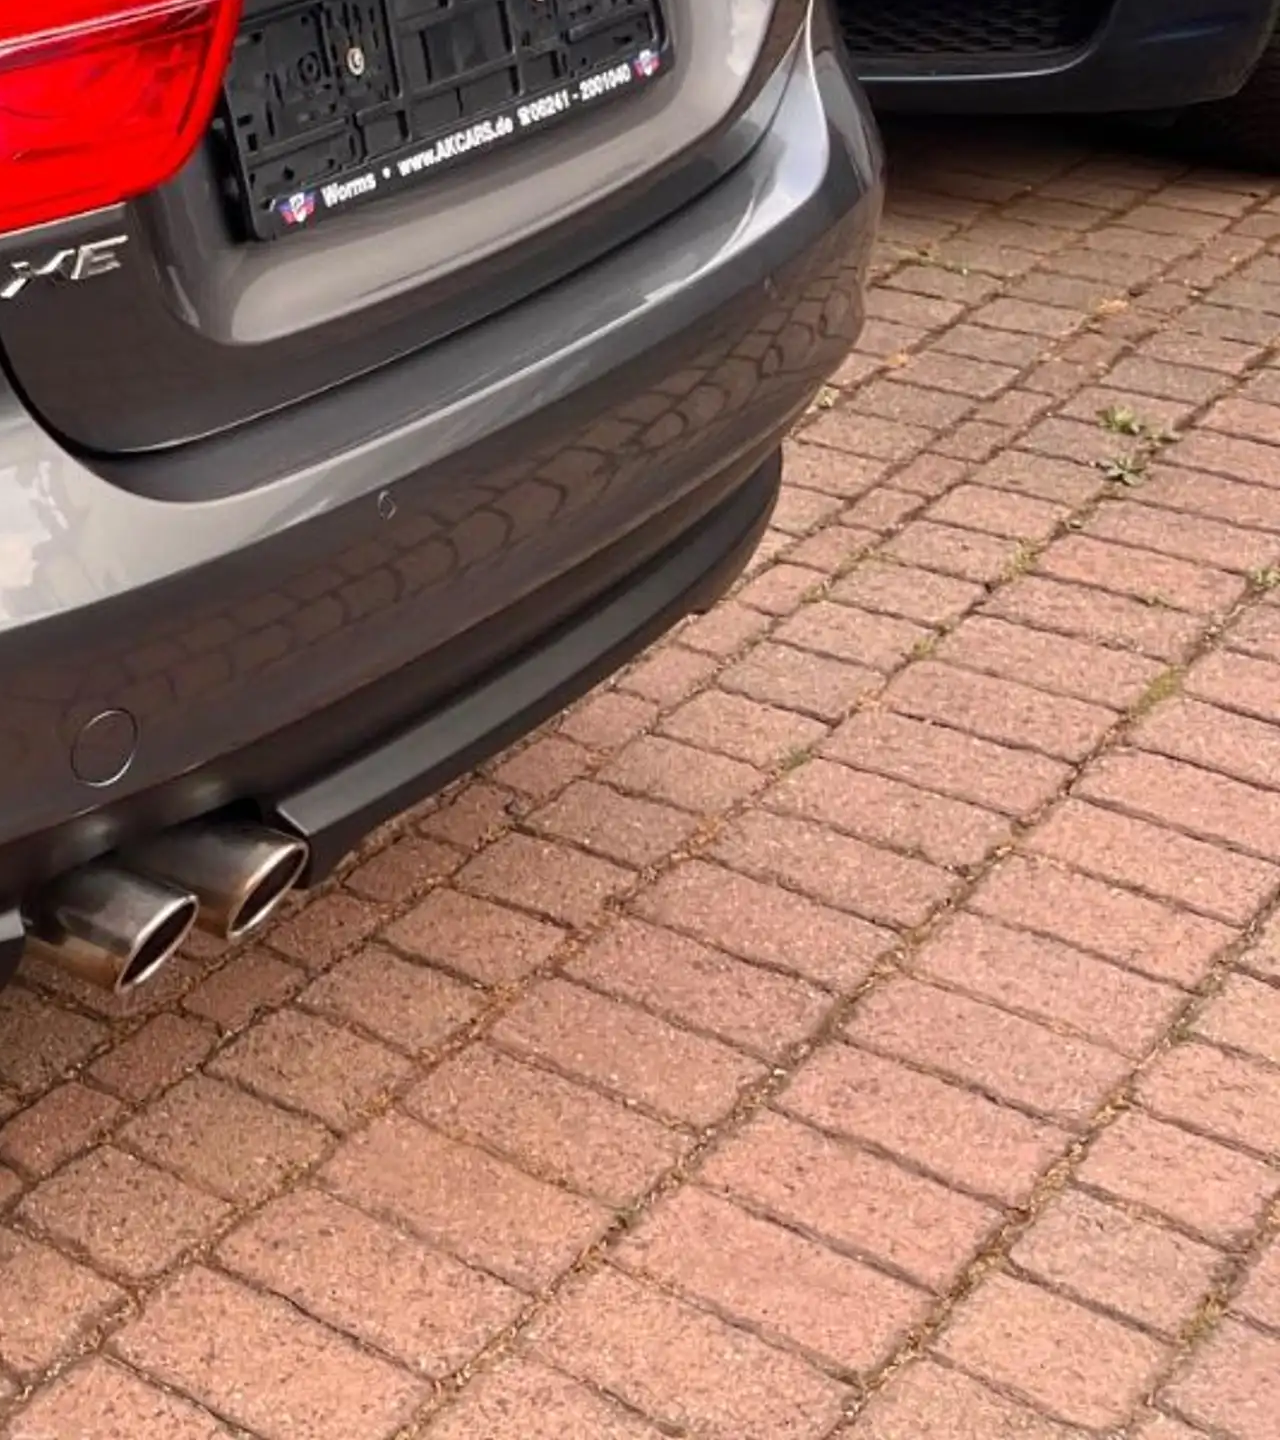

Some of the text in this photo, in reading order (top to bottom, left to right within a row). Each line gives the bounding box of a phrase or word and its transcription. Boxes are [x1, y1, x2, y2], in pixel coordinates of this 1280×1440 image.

[320, 172, 378, 209] Worms
[397, 114, 515, 178] www.AKCARS.de
[0, 234, 130, 299] XE
